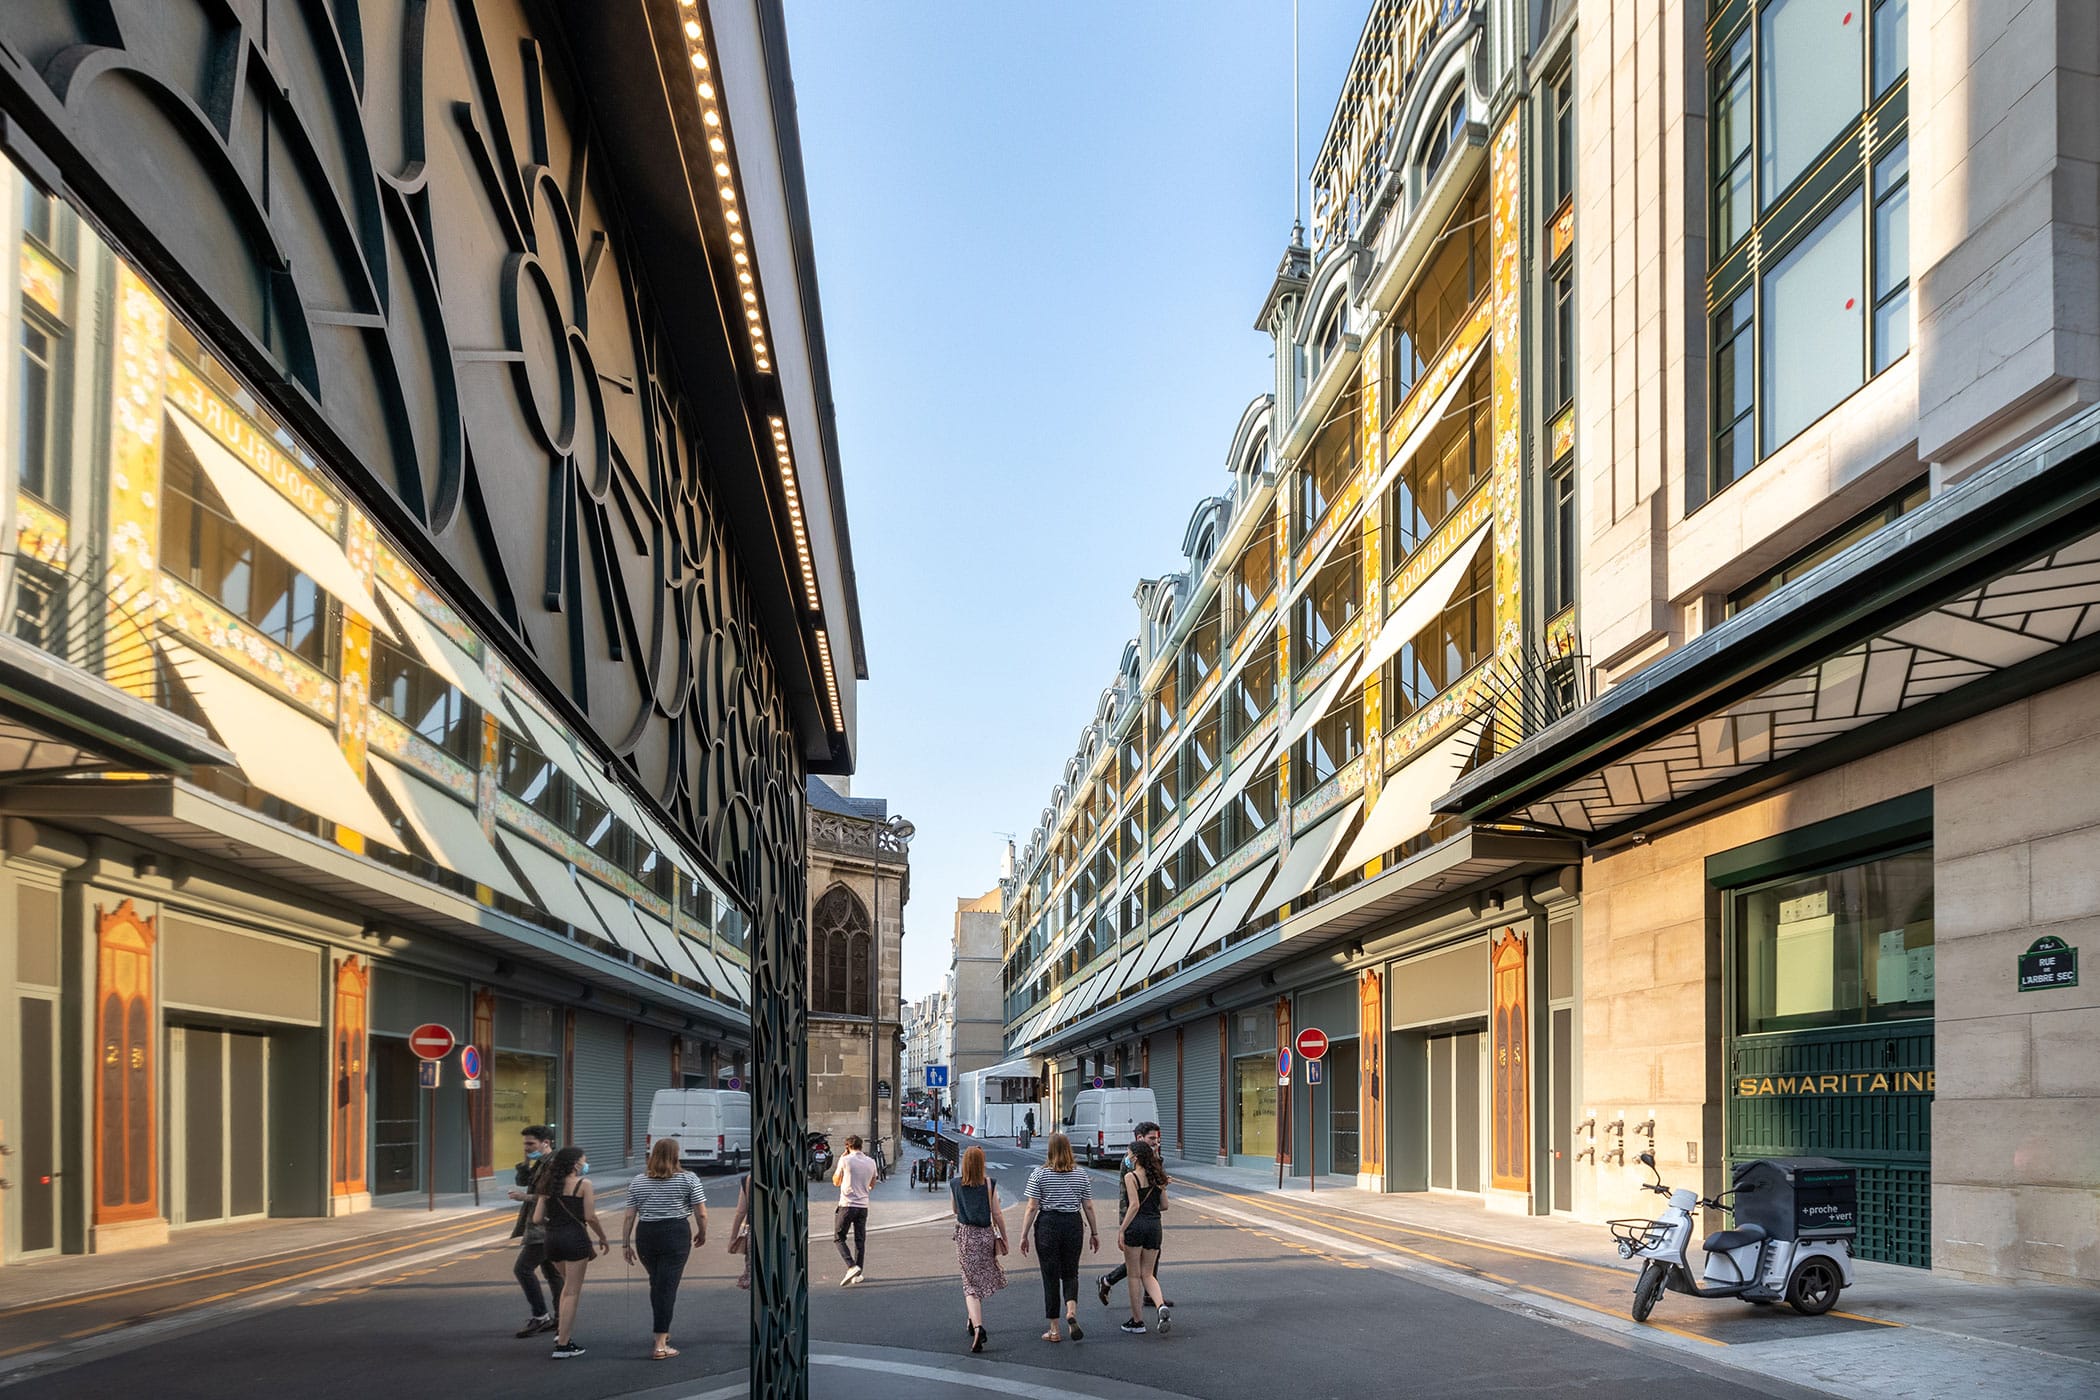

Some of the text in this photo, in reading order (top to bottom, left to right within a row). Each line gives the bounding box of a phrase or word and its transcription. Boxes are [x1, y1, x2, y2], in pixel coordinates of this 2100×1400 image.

[1313, 0, 1440, 248] SAMARITA
[1403, 497, 1481, 593] DOUBLURE
[2022, 971, 2074, 984] L'ARBRE SEC
[2039, 957, 2056, 967] RUE
